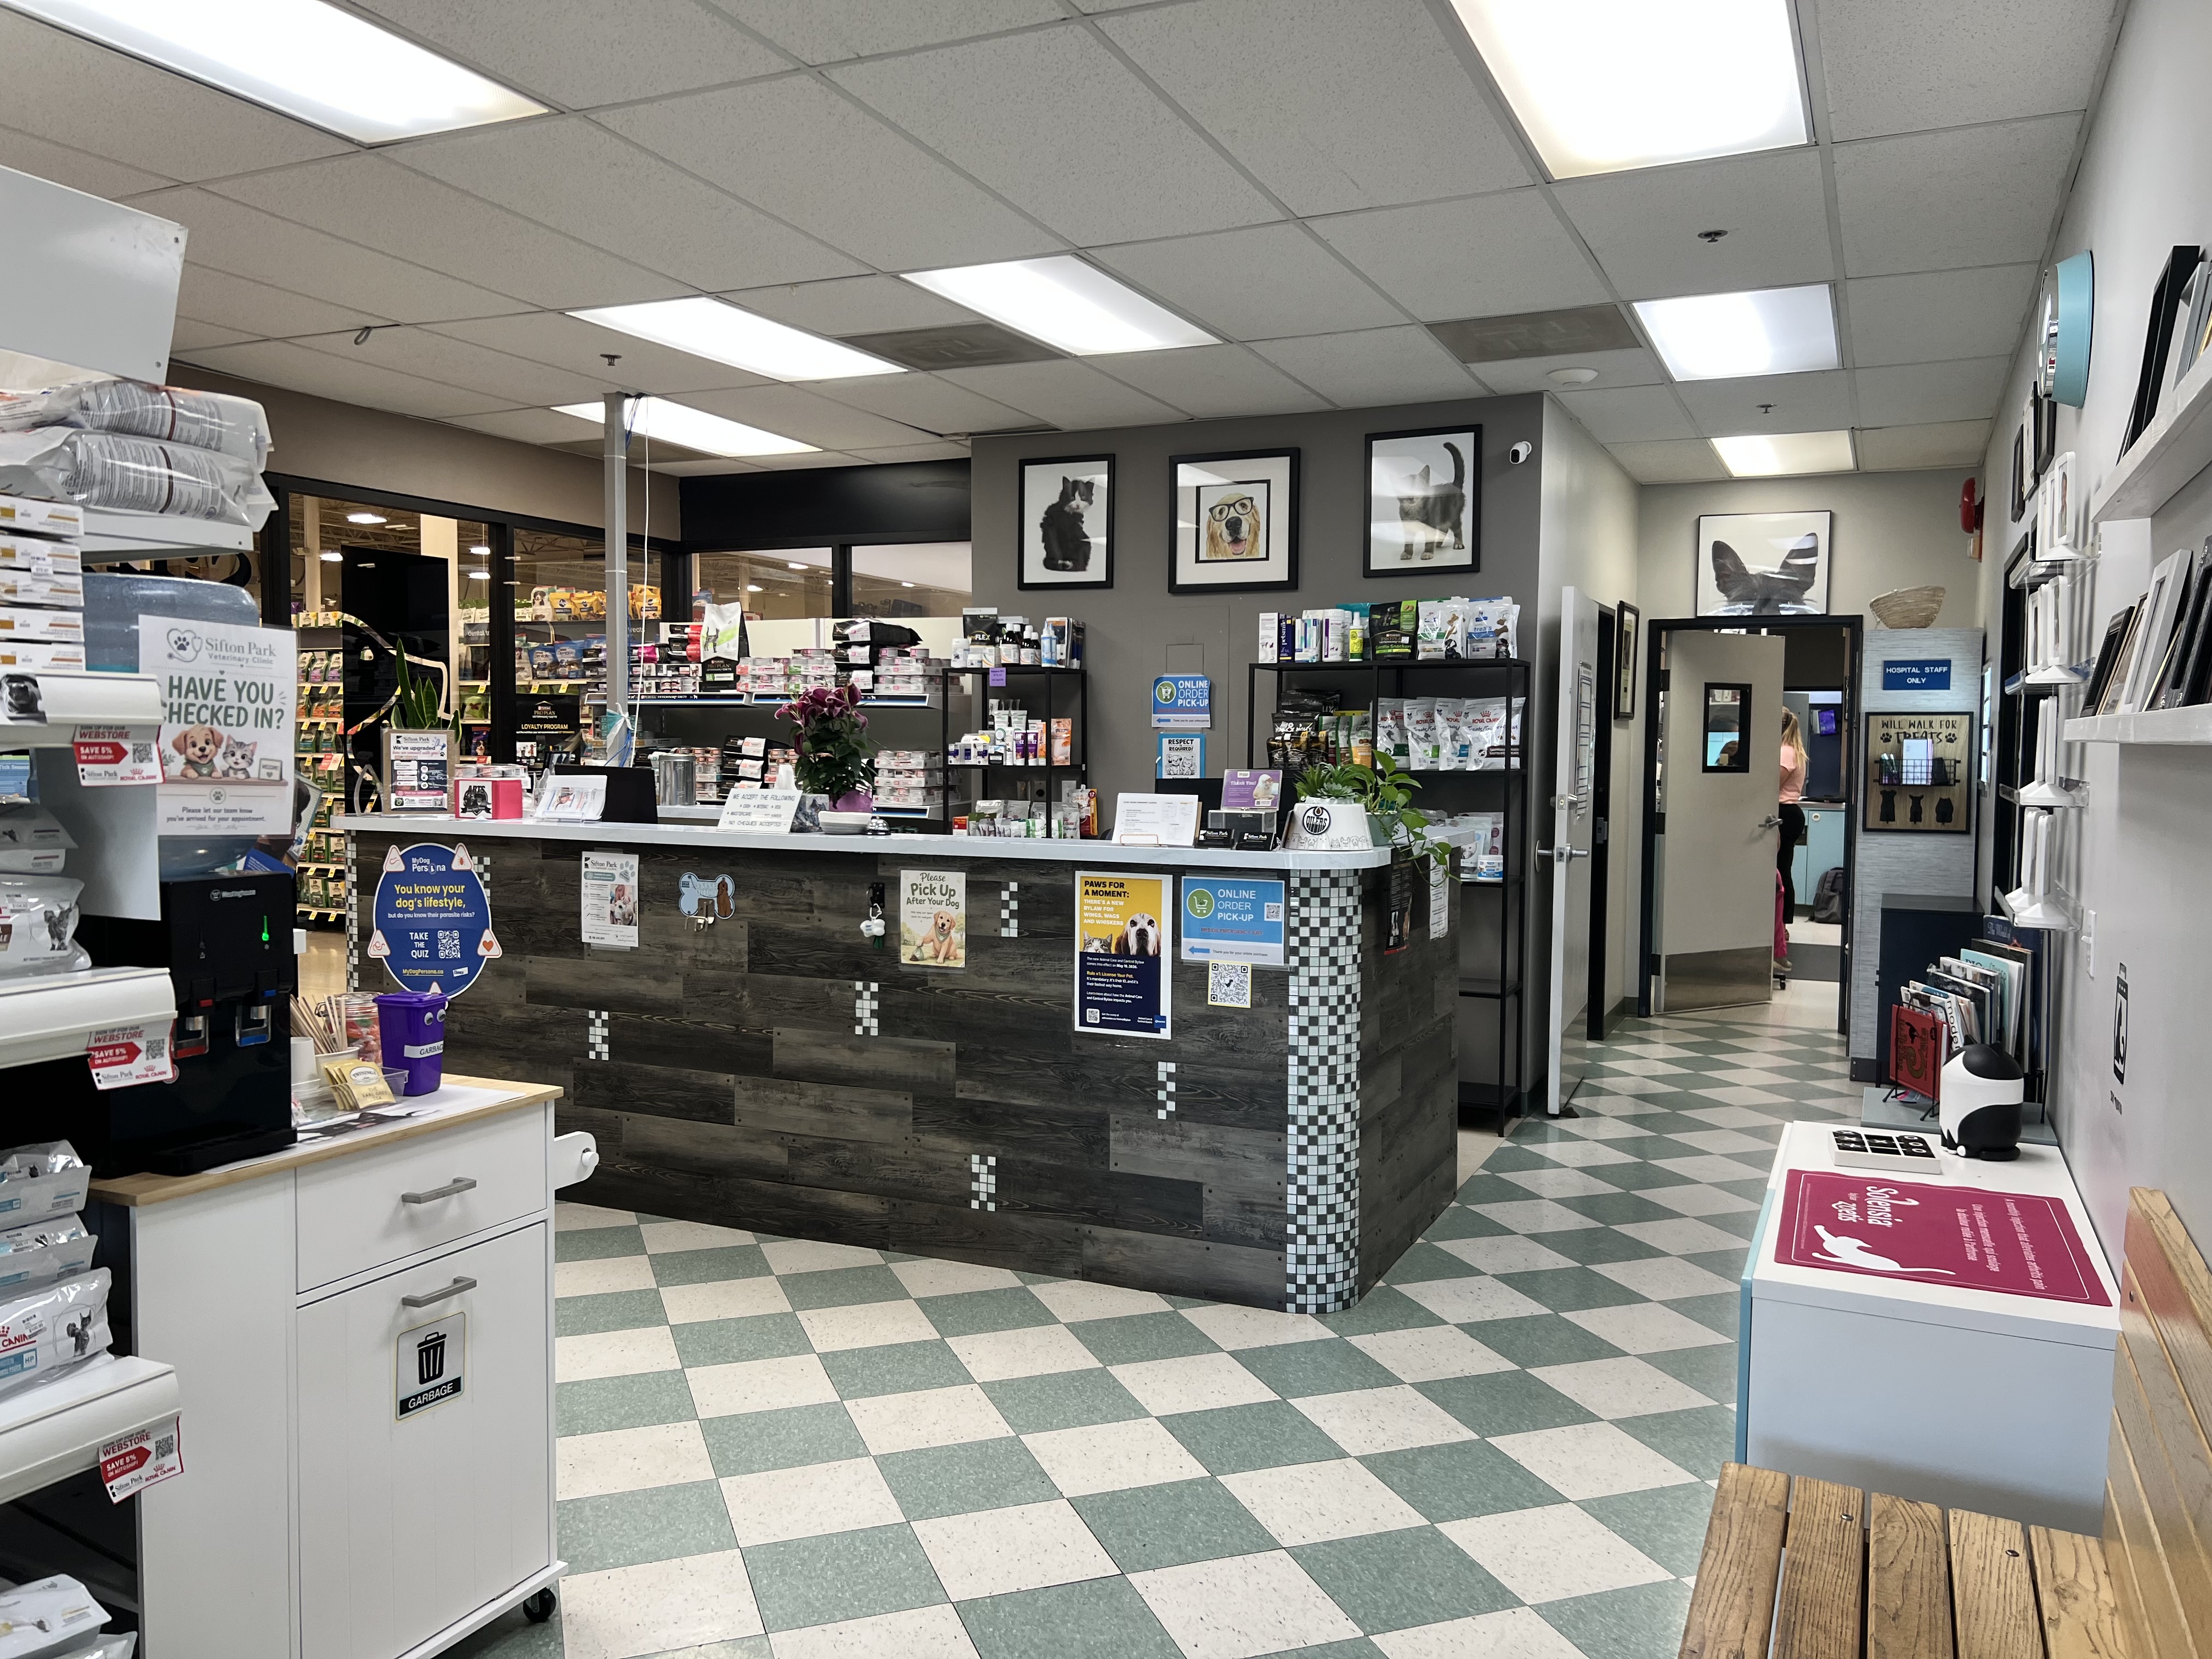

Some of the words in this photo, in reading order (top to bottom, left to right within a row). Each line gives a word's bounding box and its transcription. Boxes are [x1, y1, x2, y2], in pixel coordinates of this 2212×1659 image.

[467, 629, 484, 637] dental
[205, 637, 244, 654] Sifton
[248, 642, 276, 657] Park
[208, 653, 249, 663] Veterinary
[252, 657, 274, 665] Clinic
[168, 675, 226, 702] HAVE
[234, 680, 274, 705] YOU
[1178, 680, 1209, 689] ONLINE
[1178, 689, 1209, 699] ORDER
[1177, 699, 1209, 707] PICK-UP
[161, 699, 248, 727] HECKED
[254, 707, 284, 730] IN?
[1882, 720, 1903, 729] WILL
[1909, 720, 1934, 729] WALK
[1940, 720, 1957, 729] FOR
[80, 731, 131, 739] WEBSTORE
[1306, 815, 1327, 833] OILERS
[920, 872, 946, 882] Please
[394, 884, 413, 894] You
[414, 883, 441, 894] know
[442, 885, 465, 896] your
[911, 883, 937, 896] Pick
[939, 884, 956, 900] Up
[1091, 889, 1130, 898] MOMENT:
[1217, 889, 1256, 900] ONLINE
[396, 898, 422, 911] dog's
[424, 896, 466, 911] lifestyle,
[906, 897, 926, 905] After
[927, 897, 944, 905] Your
[945, 899, 960, 910] Dog
[1217, 901, 1251, 911] ORDER
[1217, 912, 1254, 922] PICK-UP
[409, 932, 428, 940] TAKE
[411, 950, 430, 959] QUIZ
[94, 1030, 144, 1044] WEBSTORE
[94, 1049, 114, 1058] SAVE
[1831, 1200, 1864, 1223] zoetis
[1864, 1186, 1920, 1227] Solensia
[2005, 1201, 2021, 1217] monthly
[1972, 1211, 1989, 1227] injection
[2009, 1216, 2026, 1233] injection
[1979, 1227, 1996, 1248] mensuelle
[2017, 1233, 2030, 1242] that
[1982, 1247, 1999, 1255] qui
[1986, 1254, 2001, 1272] soulage
[2027, 1261, 2044, 1279] arthritis
[2029, 1278, 2048, 1290] pain
[408, 1383, 453, 1409] GARBAGE
[103, 1432, 151, 1457] WEBSTORE
[106, 1458, 125, 1471] SAVE
[126, 1454, 137, 1463] 5%
[115, 1482, 130, 1491] Sifton
[131, 1474, 143, 1484] Park
